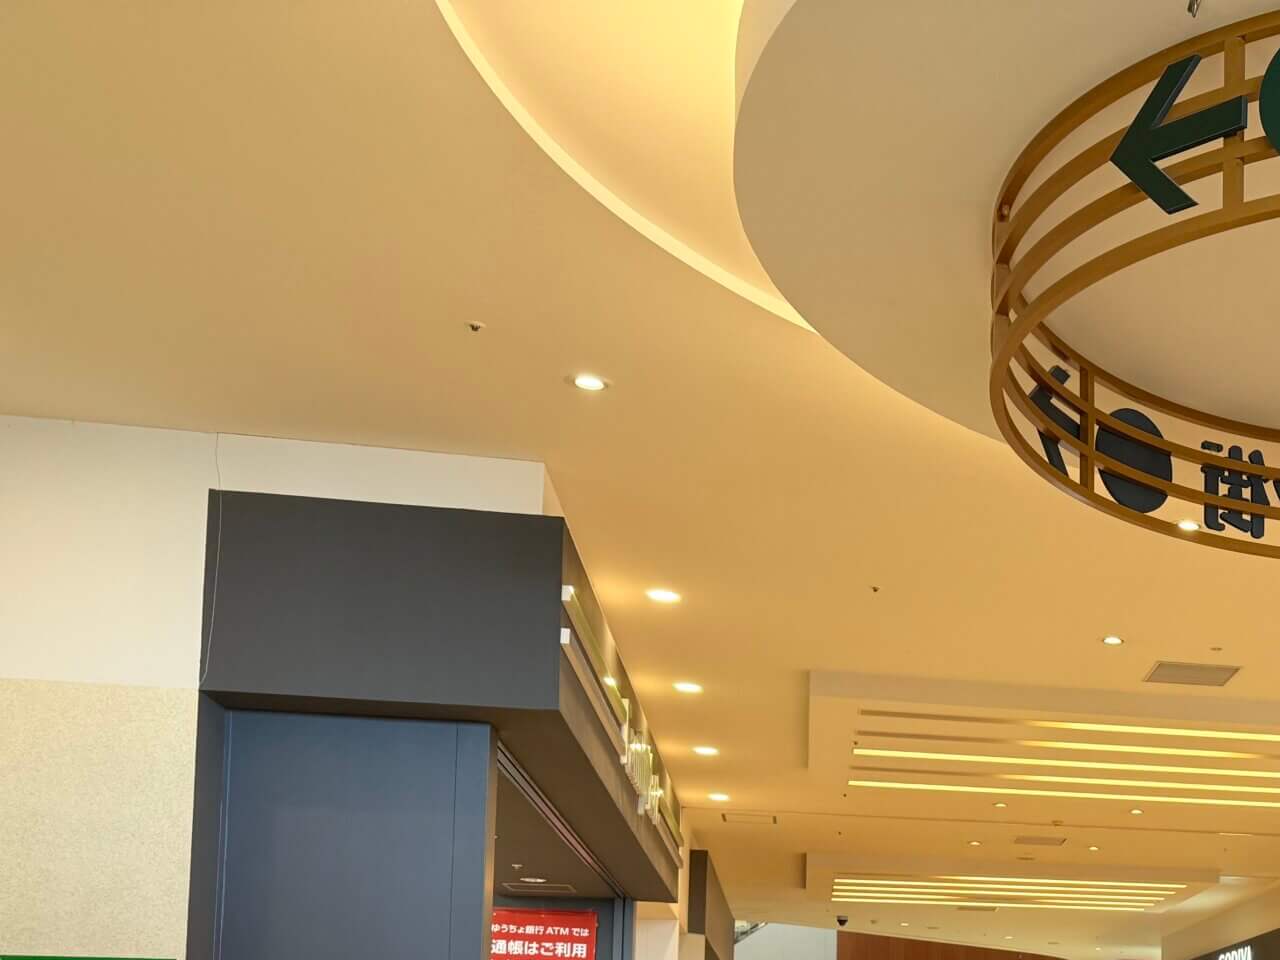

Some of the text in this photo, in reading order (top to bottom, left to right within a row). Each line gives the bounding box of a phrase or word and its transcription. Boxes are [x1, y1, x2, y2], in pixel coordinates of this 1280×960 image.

[545, 927, 570, 936] ATM
[571, 927, 590, 937] では
[490, 939, 588, 959] 通帳はご利用
